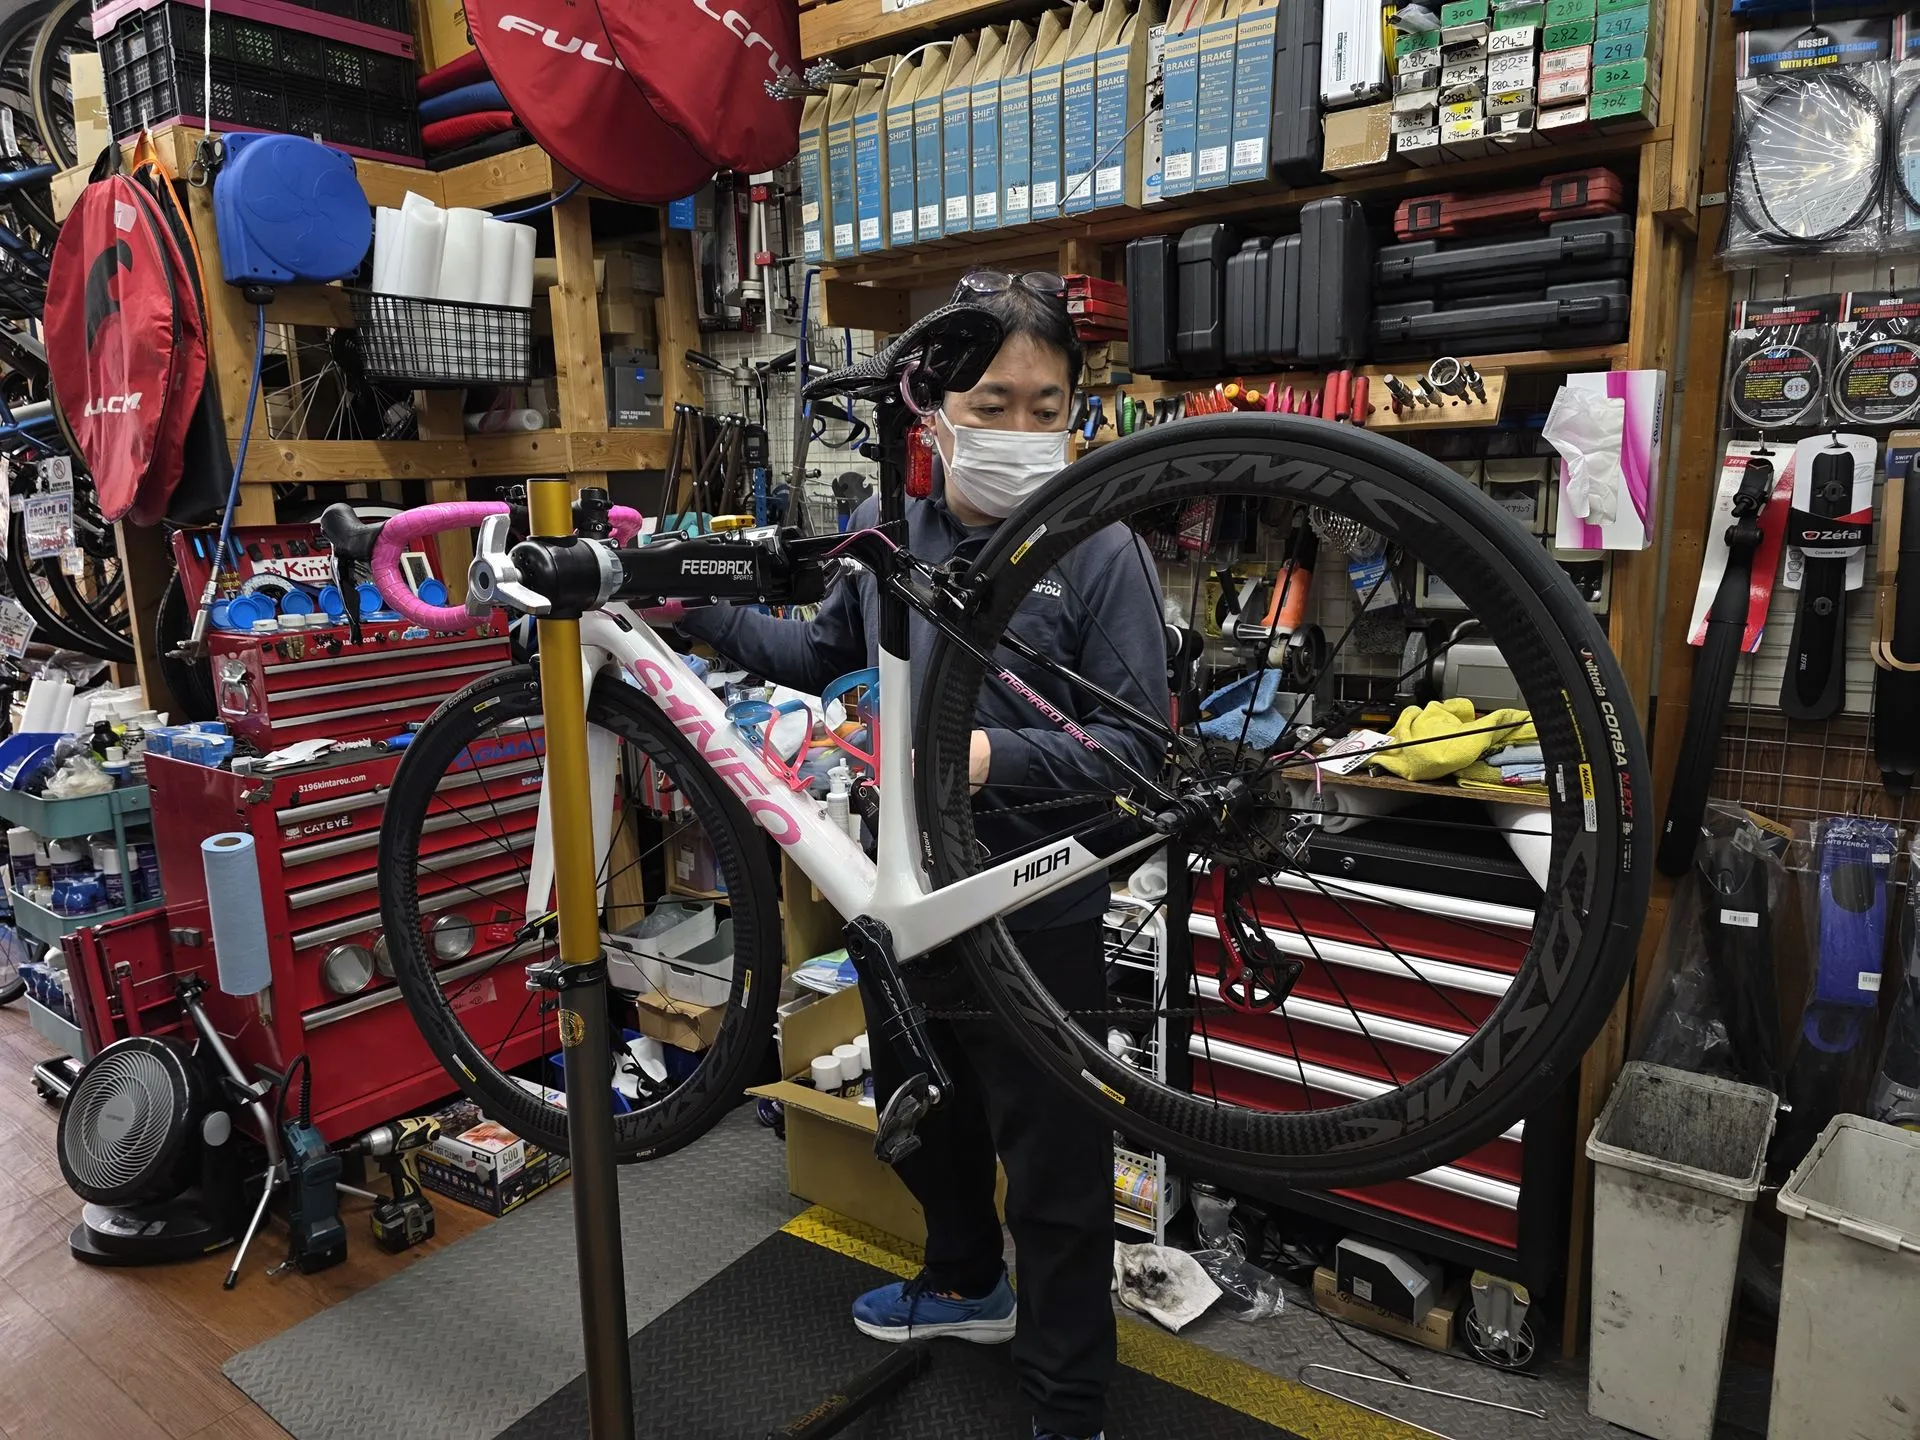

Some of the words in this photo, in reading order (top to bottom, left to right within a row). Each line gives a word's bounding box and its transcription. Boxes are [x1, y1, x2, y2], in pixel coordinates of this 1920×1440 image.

[1452, 9, 1474, 19] 300
[1606, 18, 1632, 32] 297
[1550, 28, 1578, 43] 282
[1798, 37, 1829, 48] NISSEN
[498, 15, 625, 71] FUL
[1200, 50, 1232, 64] BRAKE
[1604, 44, 1632, 59] 299
[1750, 53, 1793, 64] STAINLESS
[1794, 50, 1817, 60] STEEL
[1166, 58, 1195, 72] BRAKE
[1780, 59, 1802, 69] WITH
[1803, 55, 1838, 67] PE-LINER
[1097, 75, 1125, 88] BRAKE
[1606, 70, 1631, 83] 302
[1064, 83, 1092, 96] BRAKE
[1032, 93, 1058, 105] BRAKE
[973, 107, 996, 120] SHIFT
[1003, 101, 1028, 113] BRAKE
[888, 129, 911, 141] SHIFT
[916, 122, 938, 135] SHIFT
[1821, 530, 1862, 540] Zéfal
[681, 559, 753, 575] FEEDBACK
[1032, 583, 1062, 597] arou
[998, 671, 1062, 725] INSPIRED
[1062, 719, 1101, 754] BIKE
[1584, 659, 1607, 697] vittoria
[1601, 701, 1628, 766] CORSA
[298, 774, 367, 793] 3196kintarou.com
[1582, 767, 1592, 796] MAVIC
[303, 816, 353, 834] CATEYE
[1013, 846, 1071, 888] HIDA
